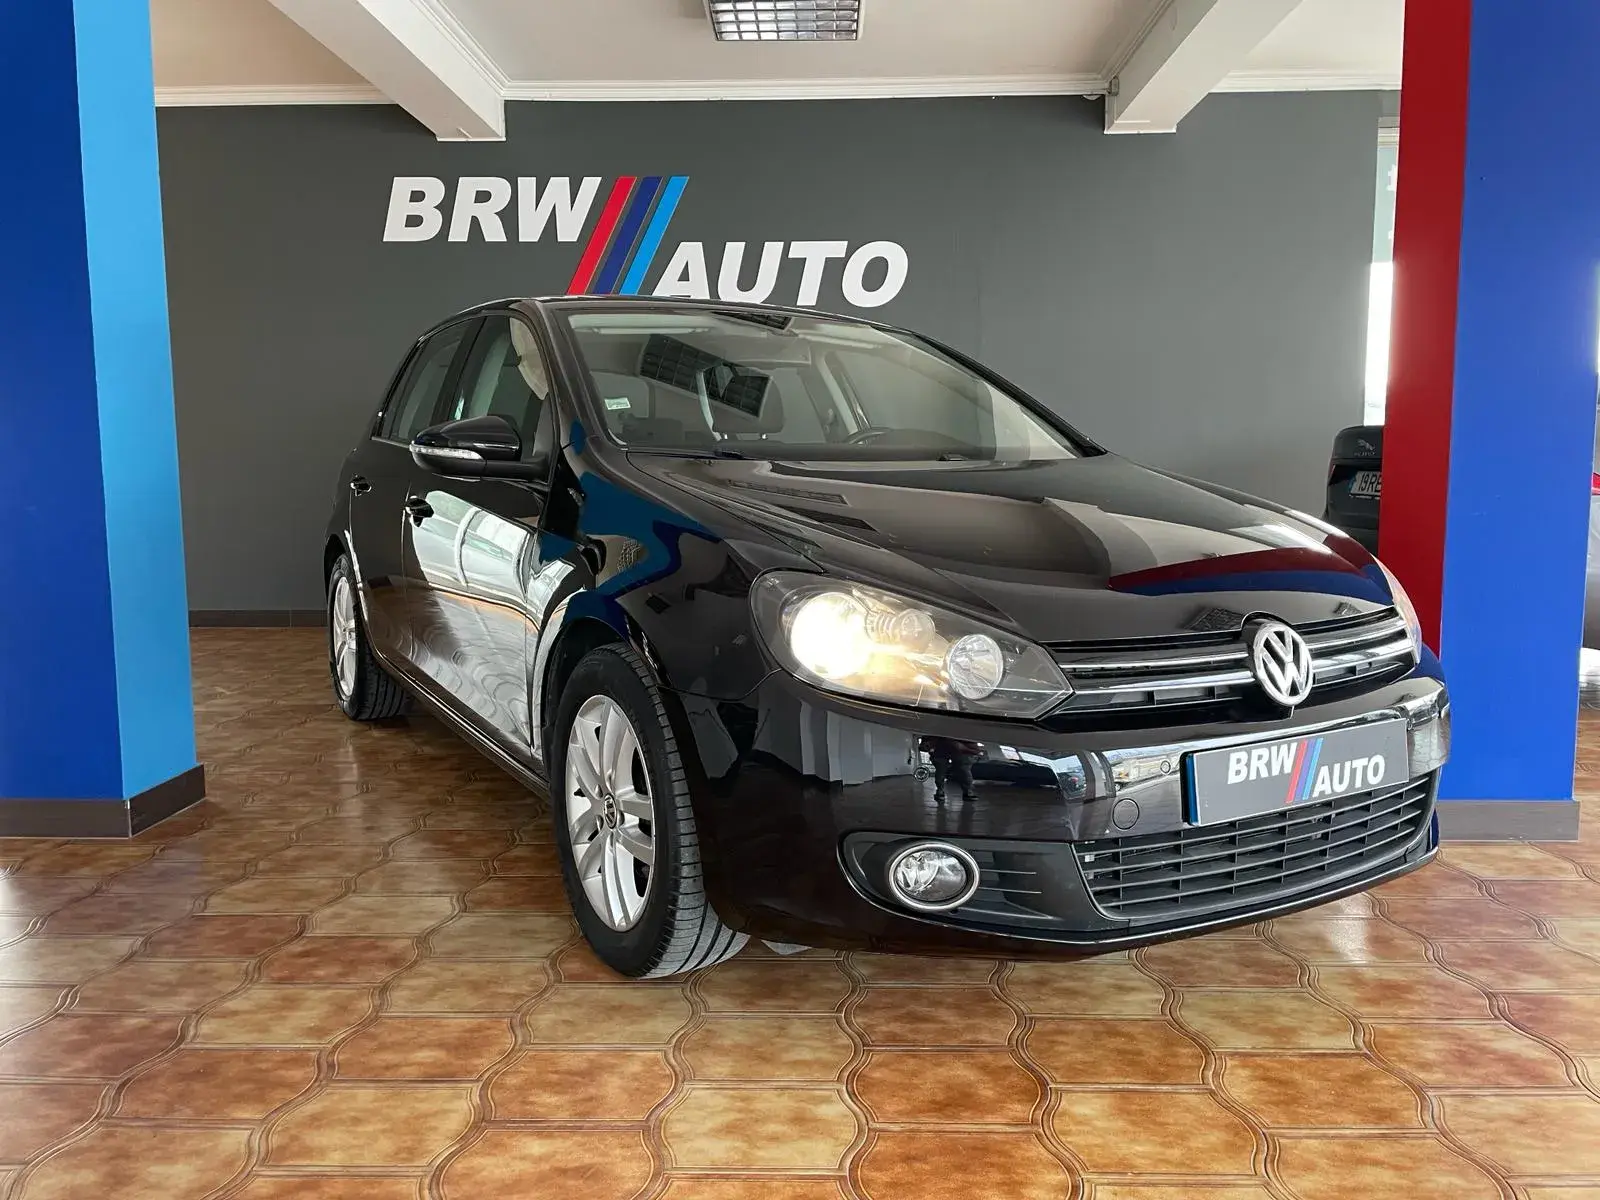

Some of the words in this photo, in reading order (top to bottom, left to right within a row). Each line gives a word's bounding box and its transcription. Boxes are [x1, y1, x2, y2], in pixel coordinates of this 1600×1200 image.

[382, 176, 602, 242] BRW
[651, 240, 909, 307] AUTO
[1227, 742, 1298, 785] BRW
[1312, 754, 1386, 798] AUTO
